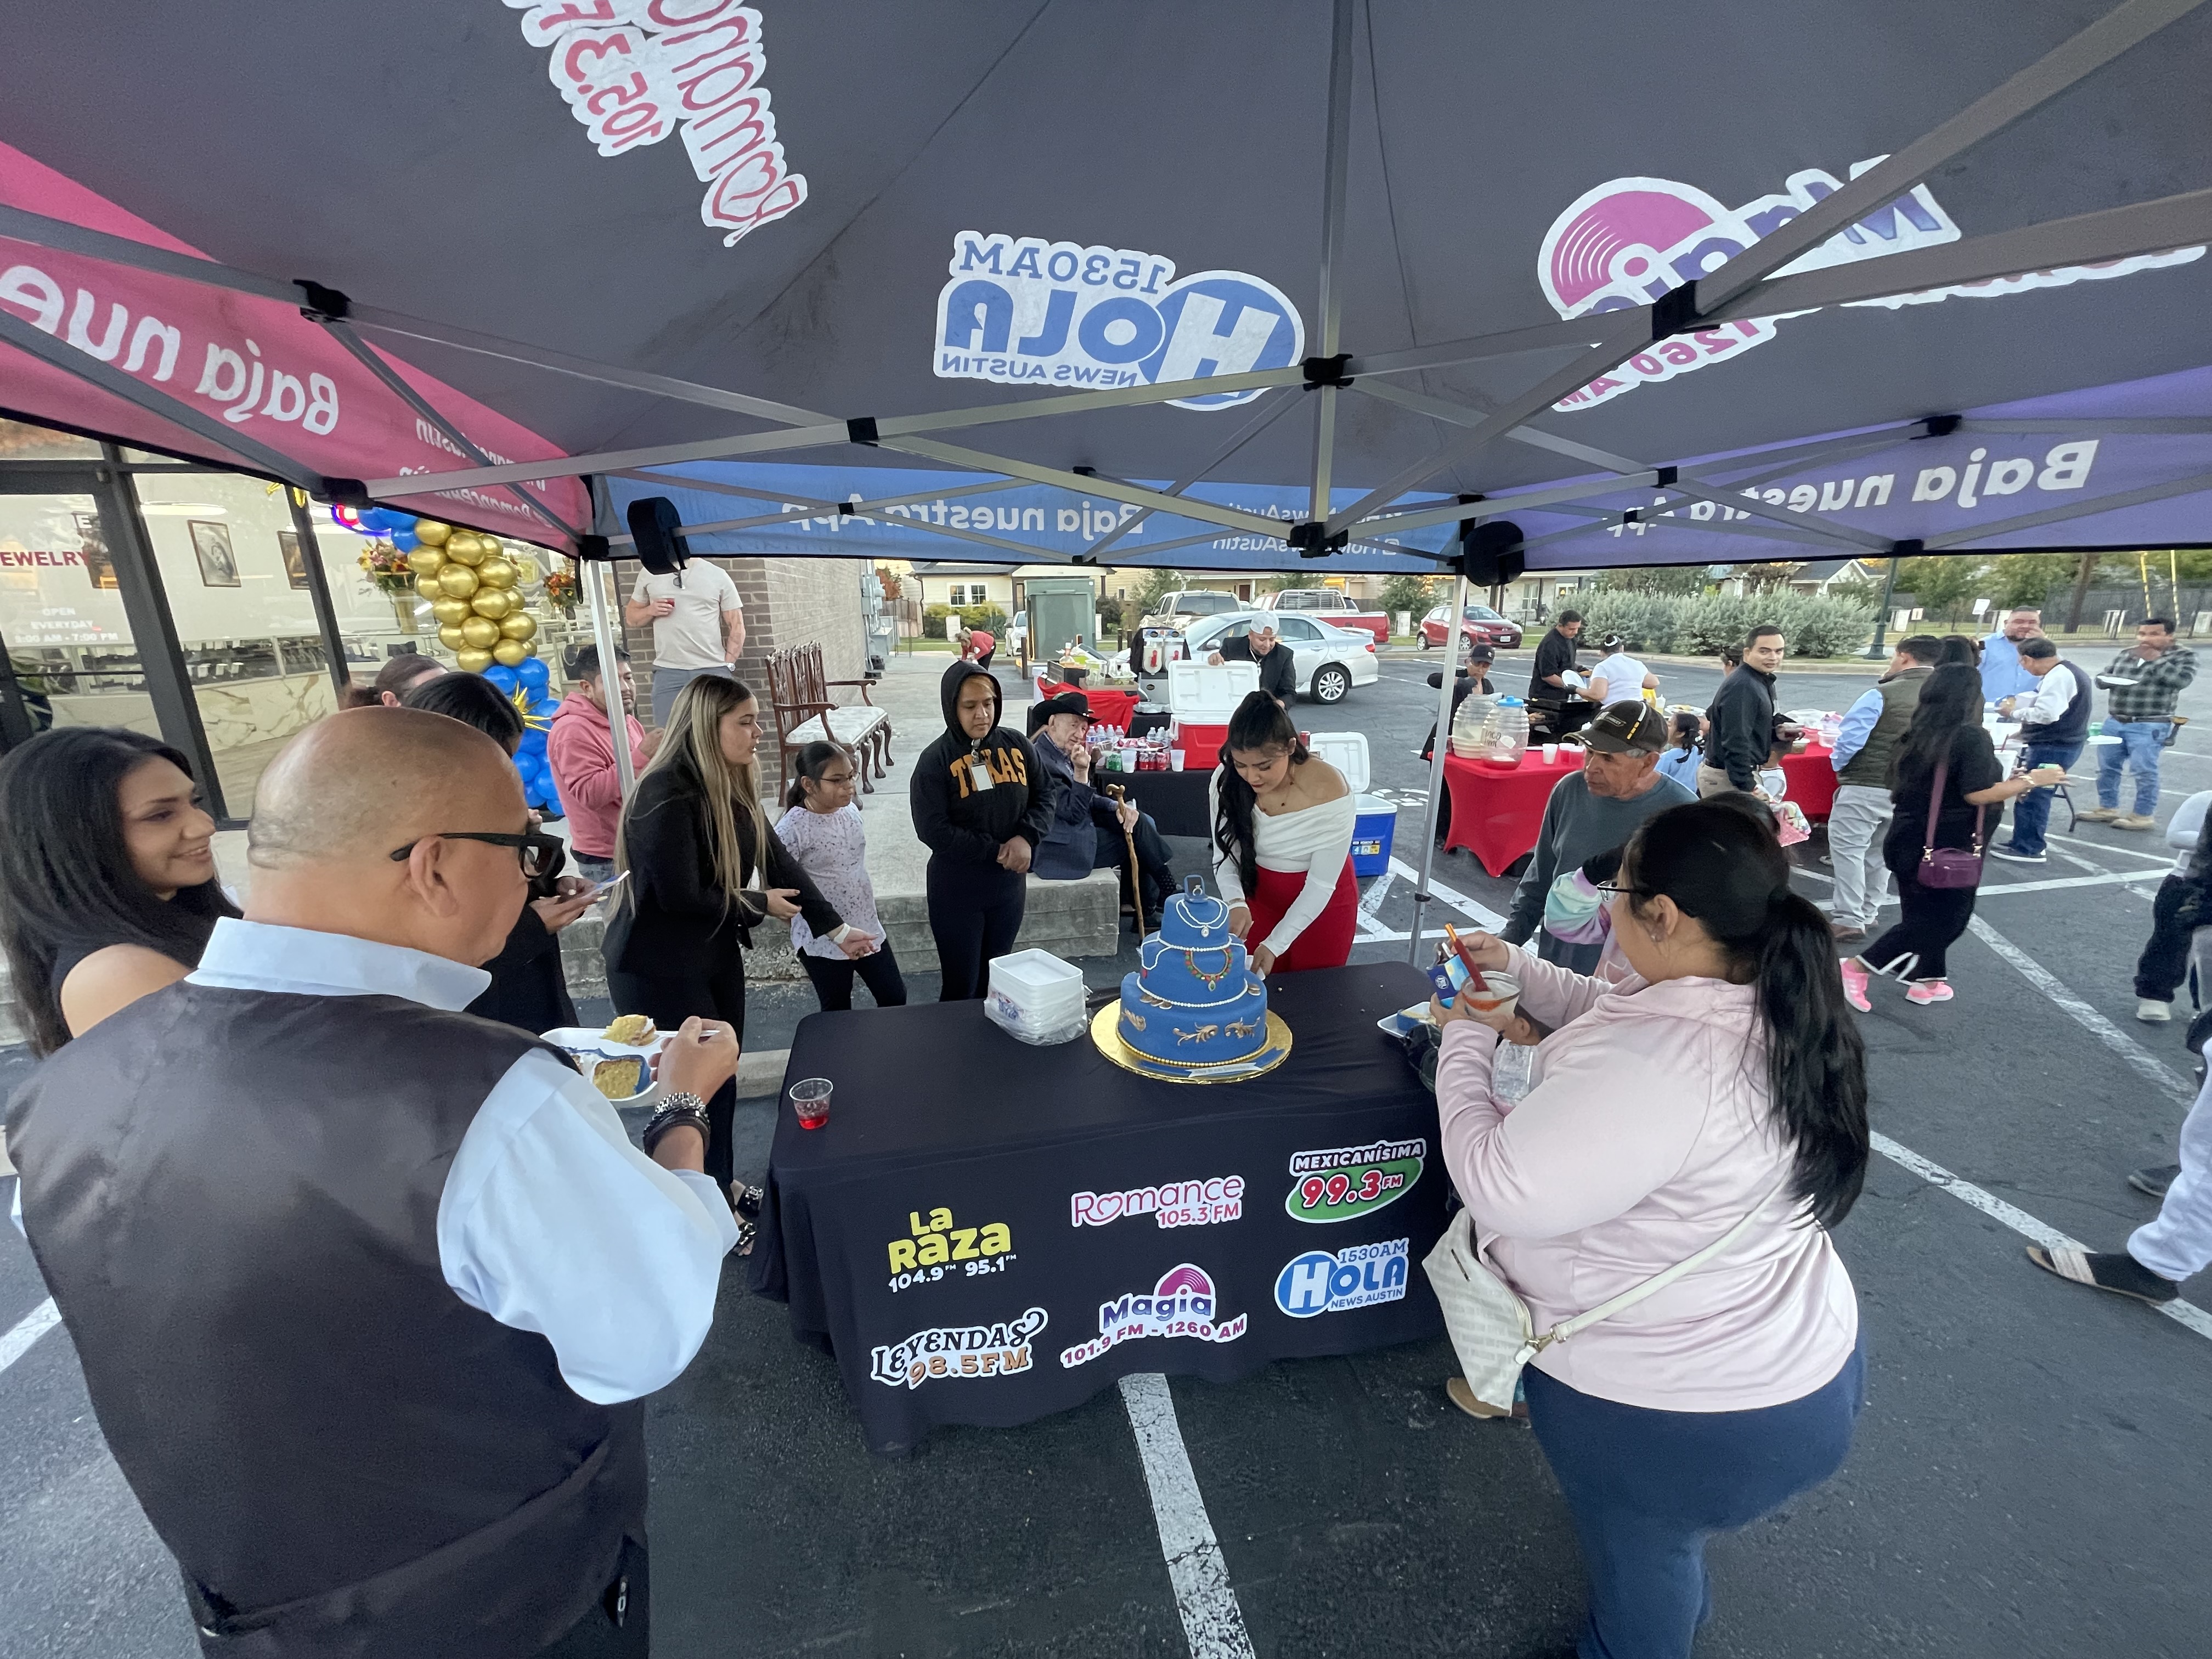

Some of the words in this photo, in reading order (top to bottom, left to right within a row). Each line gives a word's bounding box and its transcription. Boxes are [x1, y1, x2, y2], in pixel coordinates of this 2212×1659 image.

[0, 551, 91, 567] EWELRY
[31, 620, 93, 629] EVERYDAY
[42, 607, 76, 616] OPEN
[950, 747, 1027, 799] TXAS
[1075, 1178, 1242, 1223] Romance
[1302, 1170, 1383, 1208] 99.3
[1382, 1175, 1403, 1189] FM
[910, 1207, 953, 1236] La
[1158, 1207, 1207, 1225] 105.3
[1214, 1203, 1239, 1220] FM
[888, 1222, 1012, 1274] Raza
[1340, 1240, 1407, 1263] 1530AM
[888, 1267, 944, 1293] 104.9
[965, 1256, 1005, 1277] 95.1
[1103, 1288, 1212, 1329] Magia
[1331, 1296, 1363, 1308] NEWS
[1365, 1288, 1403, 1302] AUSTIN
[1064, 1336, 1111, 1364] 101.9
[1116, 1323, 1143, 1340] FM
[1166, 1322, 1211, 1337] 1260
[1218, 1318, 1244, 1339] AM
